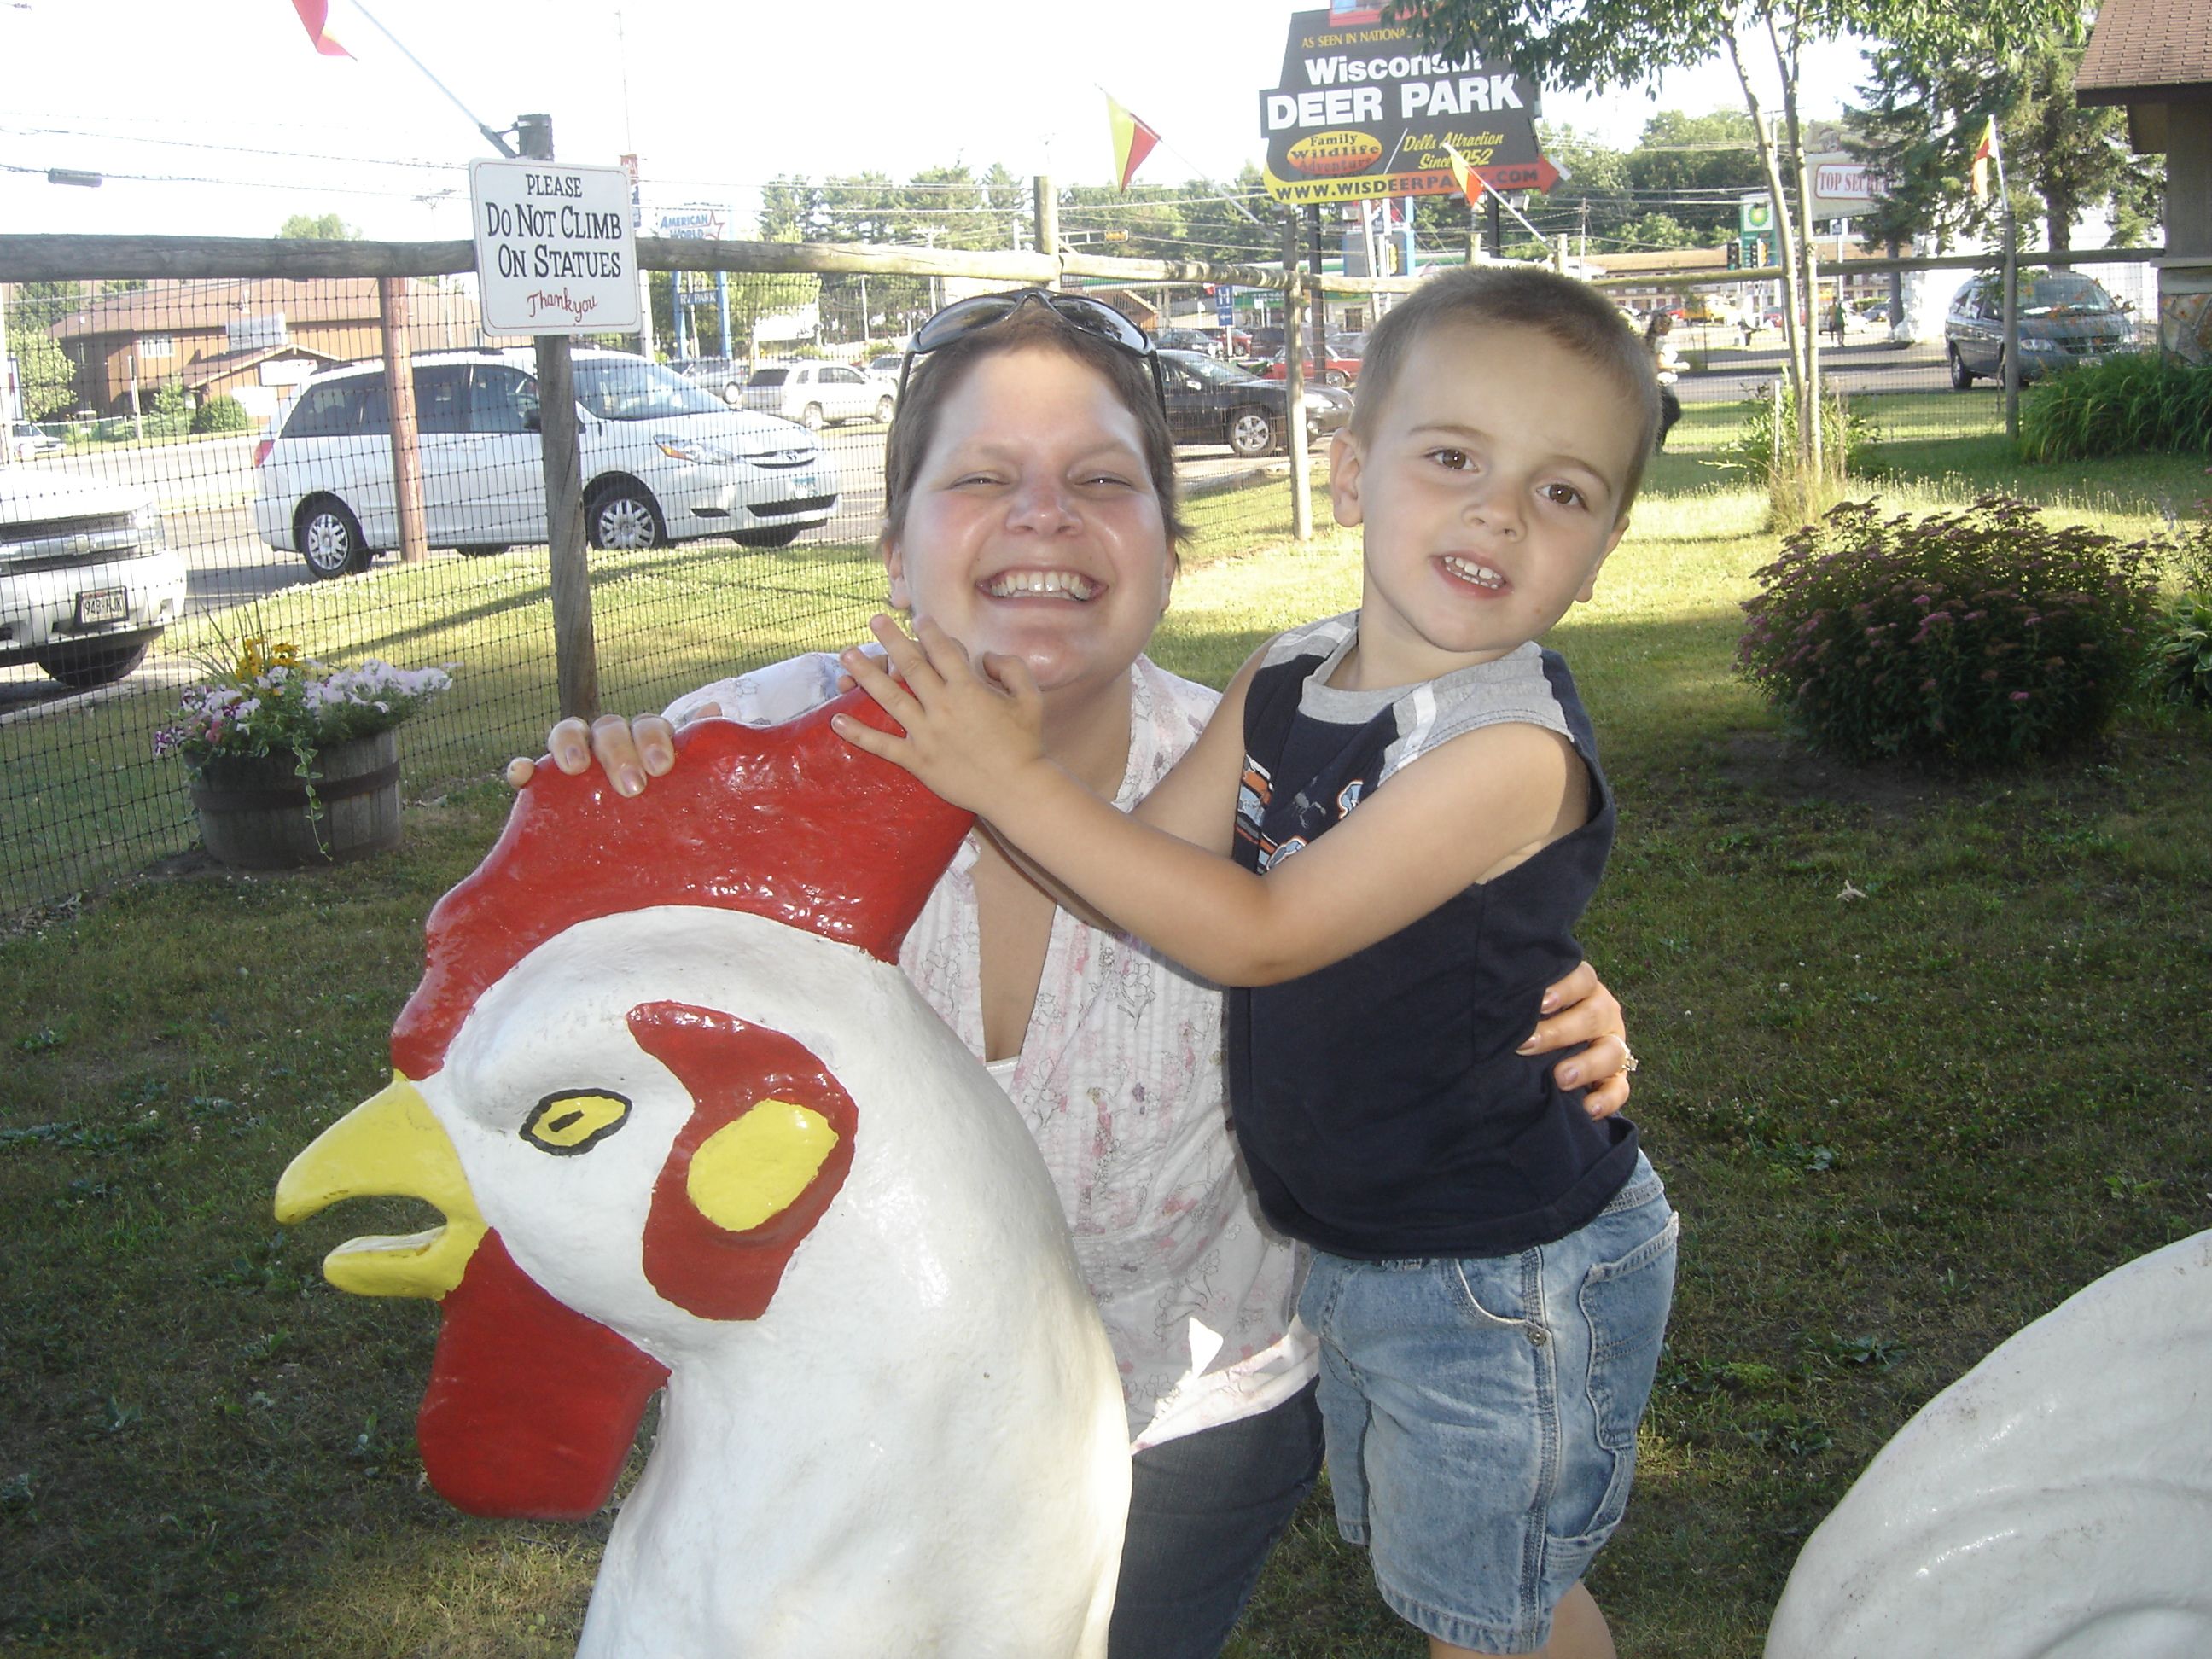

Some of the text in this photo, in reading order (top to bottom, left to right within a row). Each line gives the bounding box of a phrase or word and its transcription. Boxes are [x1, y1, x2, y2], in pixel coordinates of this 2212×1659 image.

[1302, 37, 1314, 49] AS
[1318, 34, 1342, 47] SEEN
[1346, 32, 1357, 44] IN
[1267, 73, 1524, 129] DEER PARK
[1310, 133, 1358, 147] Family
[1403, 130, 1505, 152] Dells Attraction
[1290, 144, 1379, 160] Wildlife
[526, 173, 583, 197] PLEASE
[1276, 170, 1538, 200] WWW.WISDEERPA.COM
[1819, 172, 1842, 190] TOP
[1218, 288, 1230, 305] H
